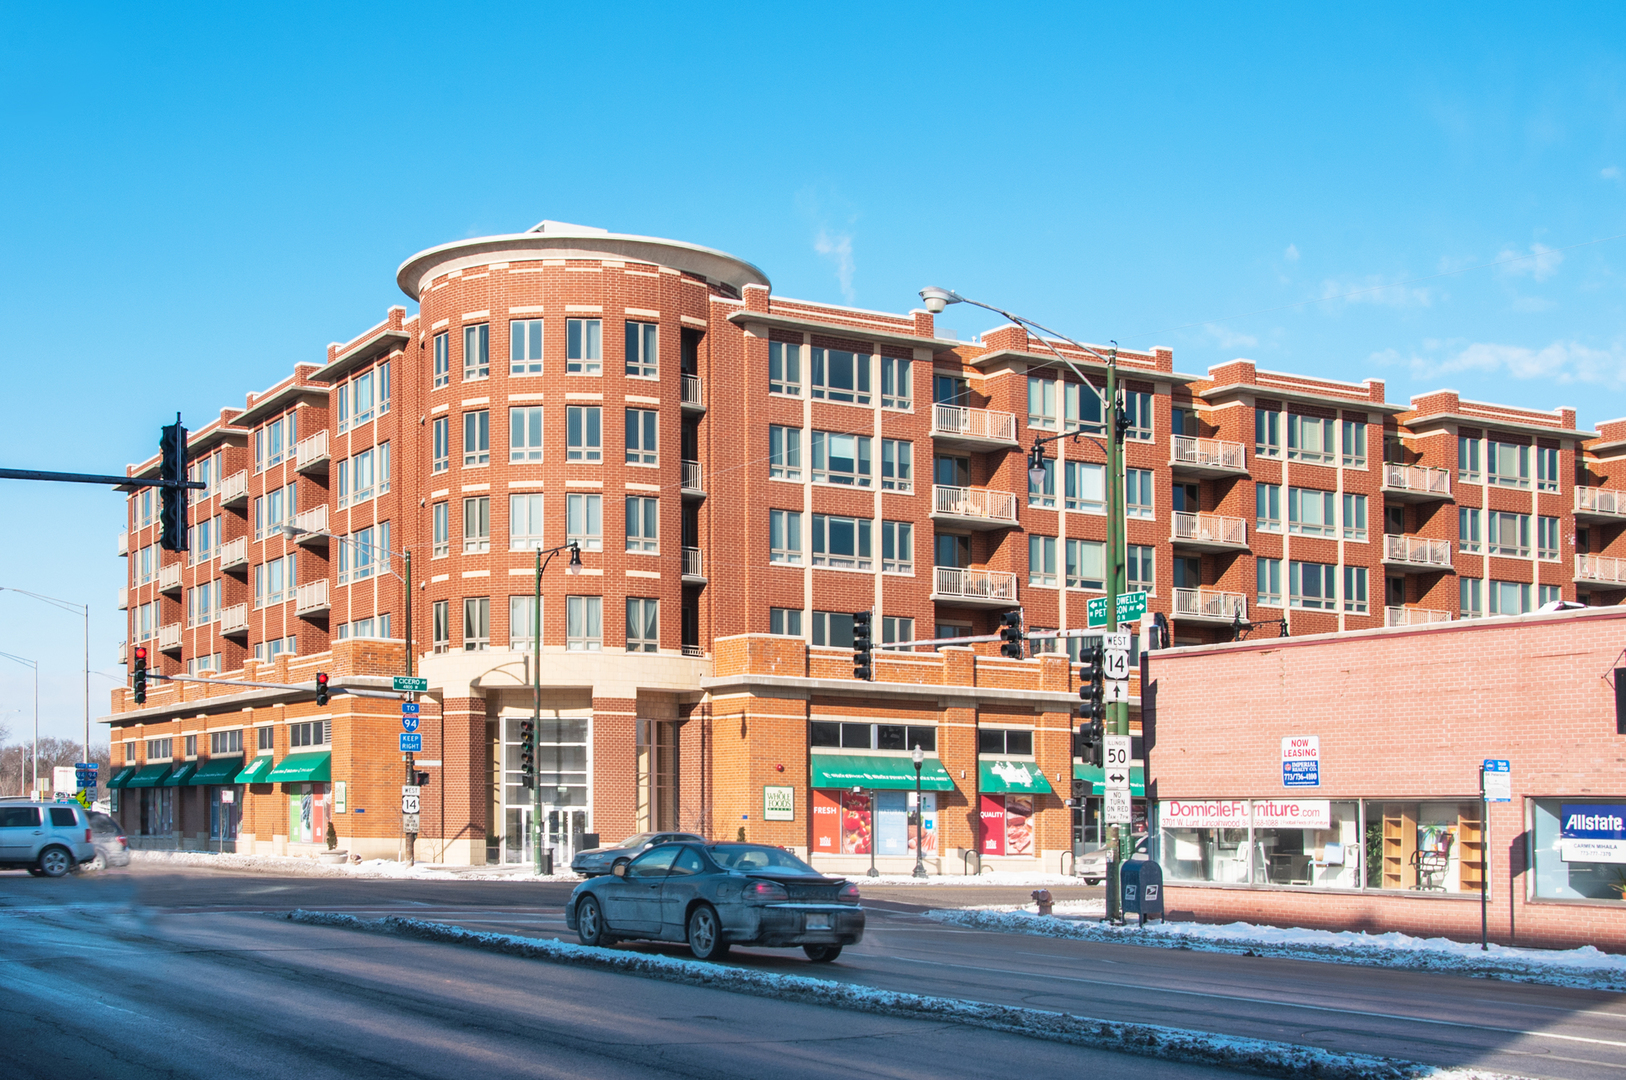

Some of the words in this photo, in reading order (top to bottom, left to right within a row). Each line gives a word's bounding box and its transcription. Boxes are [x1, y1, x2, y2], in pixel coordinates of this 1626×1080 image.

[1104, 595, 1138, 607] CDWELL
[1107, 637, 1127, 645] WEST
[1109, 655, 1125, 672] 14
[404, 719, 417, 728] 94
[1291, 739, 1309, 747] NOW
[1108, 749, 1126, 763] 50
[1283, 748, 1317, 757] LEASING
[406, 800, 416, 809] 14
[980, 811, 1003, 819] QUALITY
[1202, 819, 1240, 827] Lincolnwood
[1565, 814, 1623, 830] Allstate
